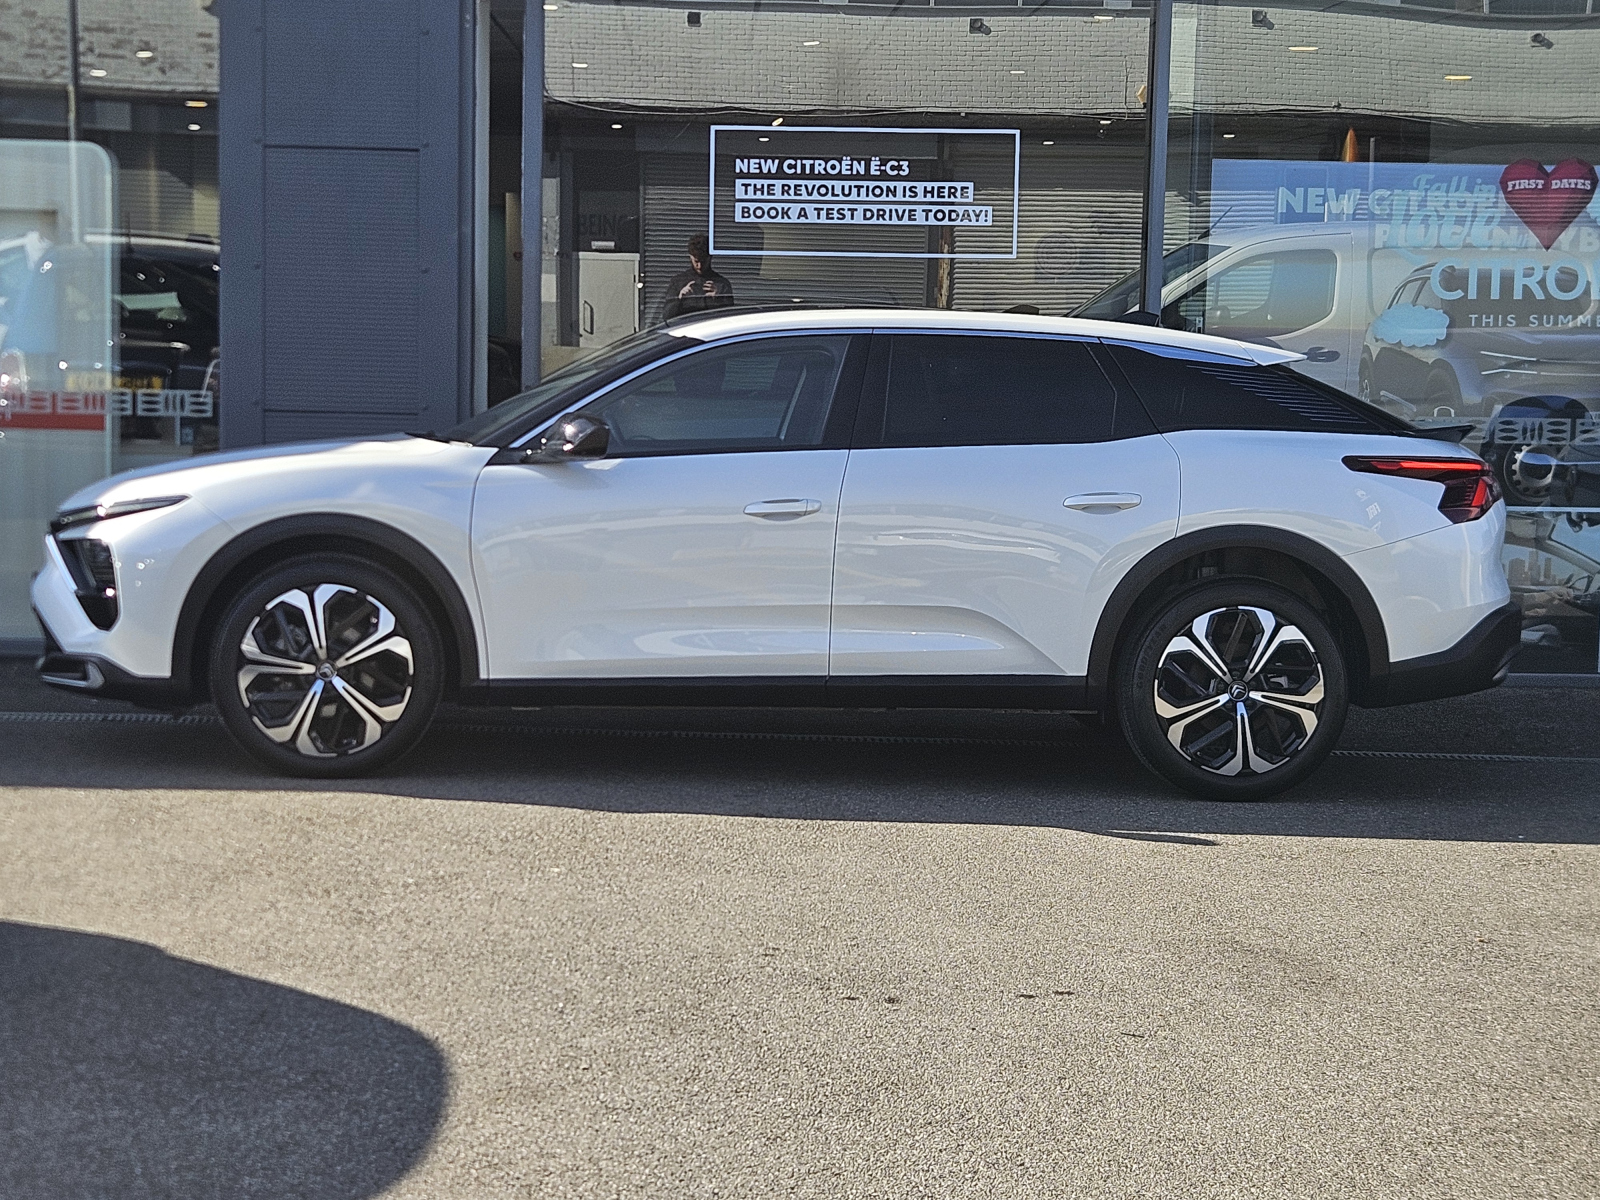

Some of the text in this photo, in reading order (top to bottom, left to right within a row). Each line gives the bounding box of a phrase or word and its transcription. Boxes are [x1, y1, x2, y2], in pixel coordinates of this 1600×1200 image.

[735, 156, 910, 176] NEW CITROËN Ë-C3
[741, 183, 970, 199] THE REVOLUTION IS HERE
[1507, 178, 1591, 191] FIRST DATES
[1278, 186, 1361, 214] NEW
[741, 206, 990, 223] BOOK A TEST DRIVE TODAY!
[1468, 314, 1517, 327] THIS
